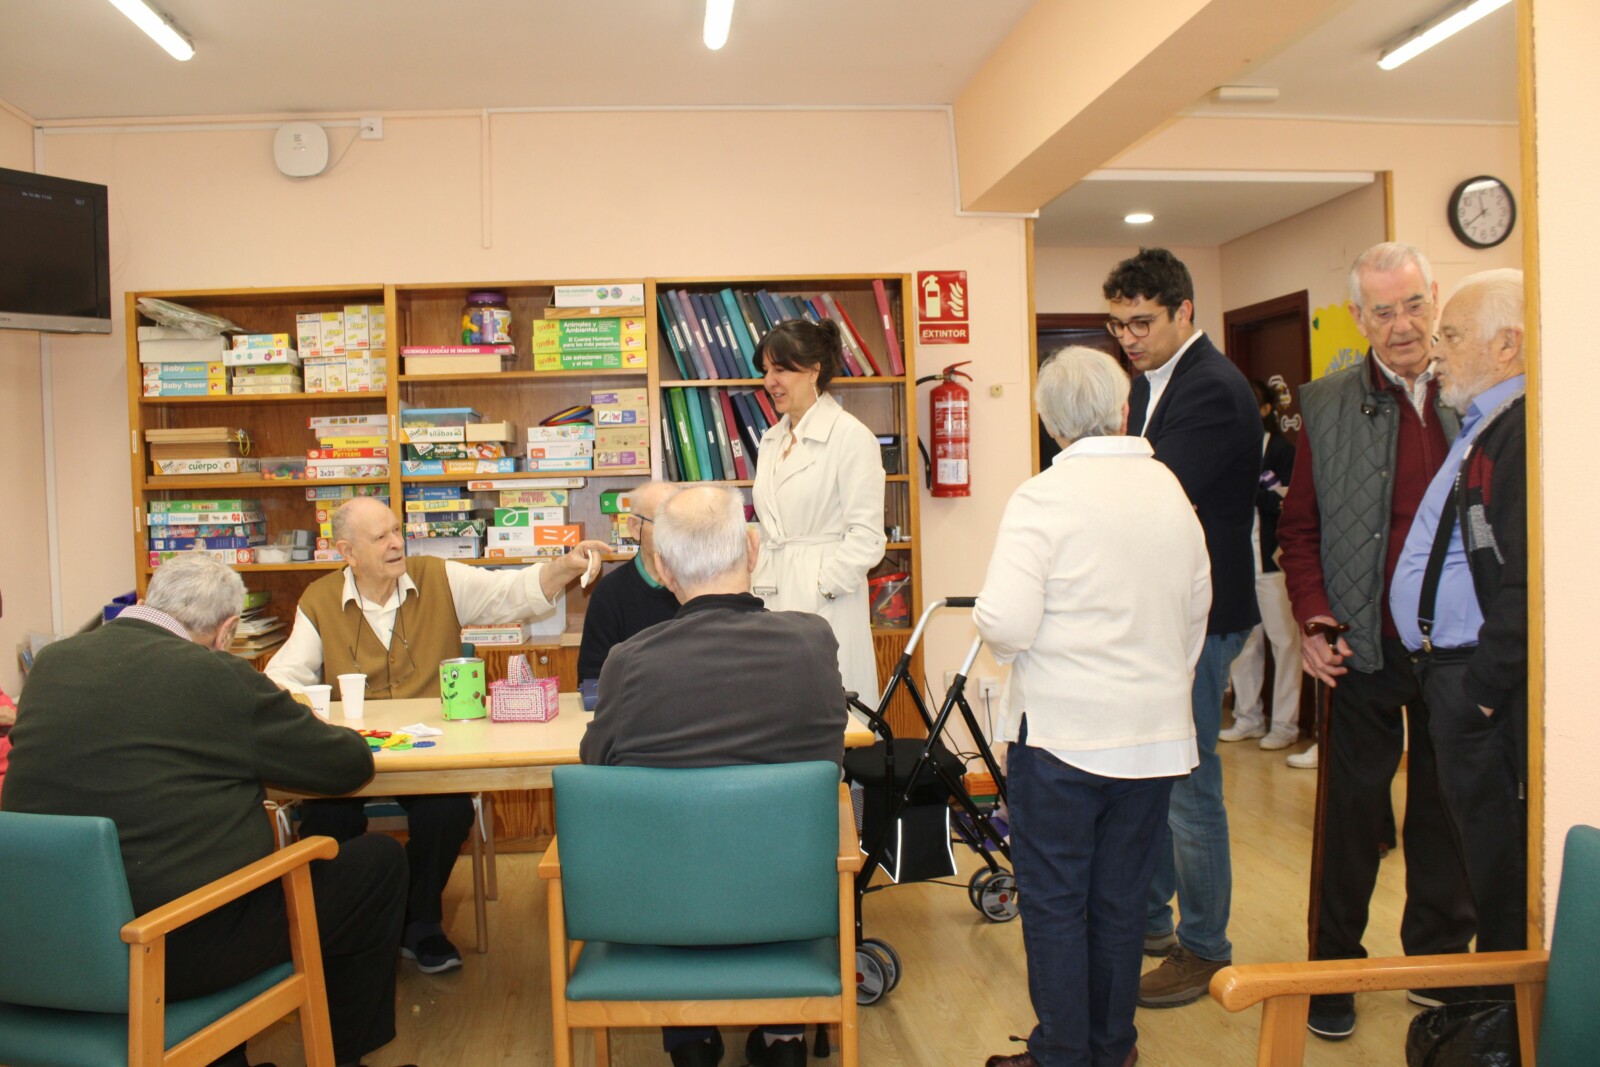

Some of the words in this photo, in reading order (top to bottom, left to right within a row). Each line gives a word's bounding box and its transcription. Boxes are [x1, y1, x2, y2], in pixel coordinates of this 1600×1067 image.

[922, 329, 967, 338] EXTINTOR
[163, 365, 185, 373] Baby
[163, 382, 182, 390] Baby
[188, 462, 218, 472] cuerpo
